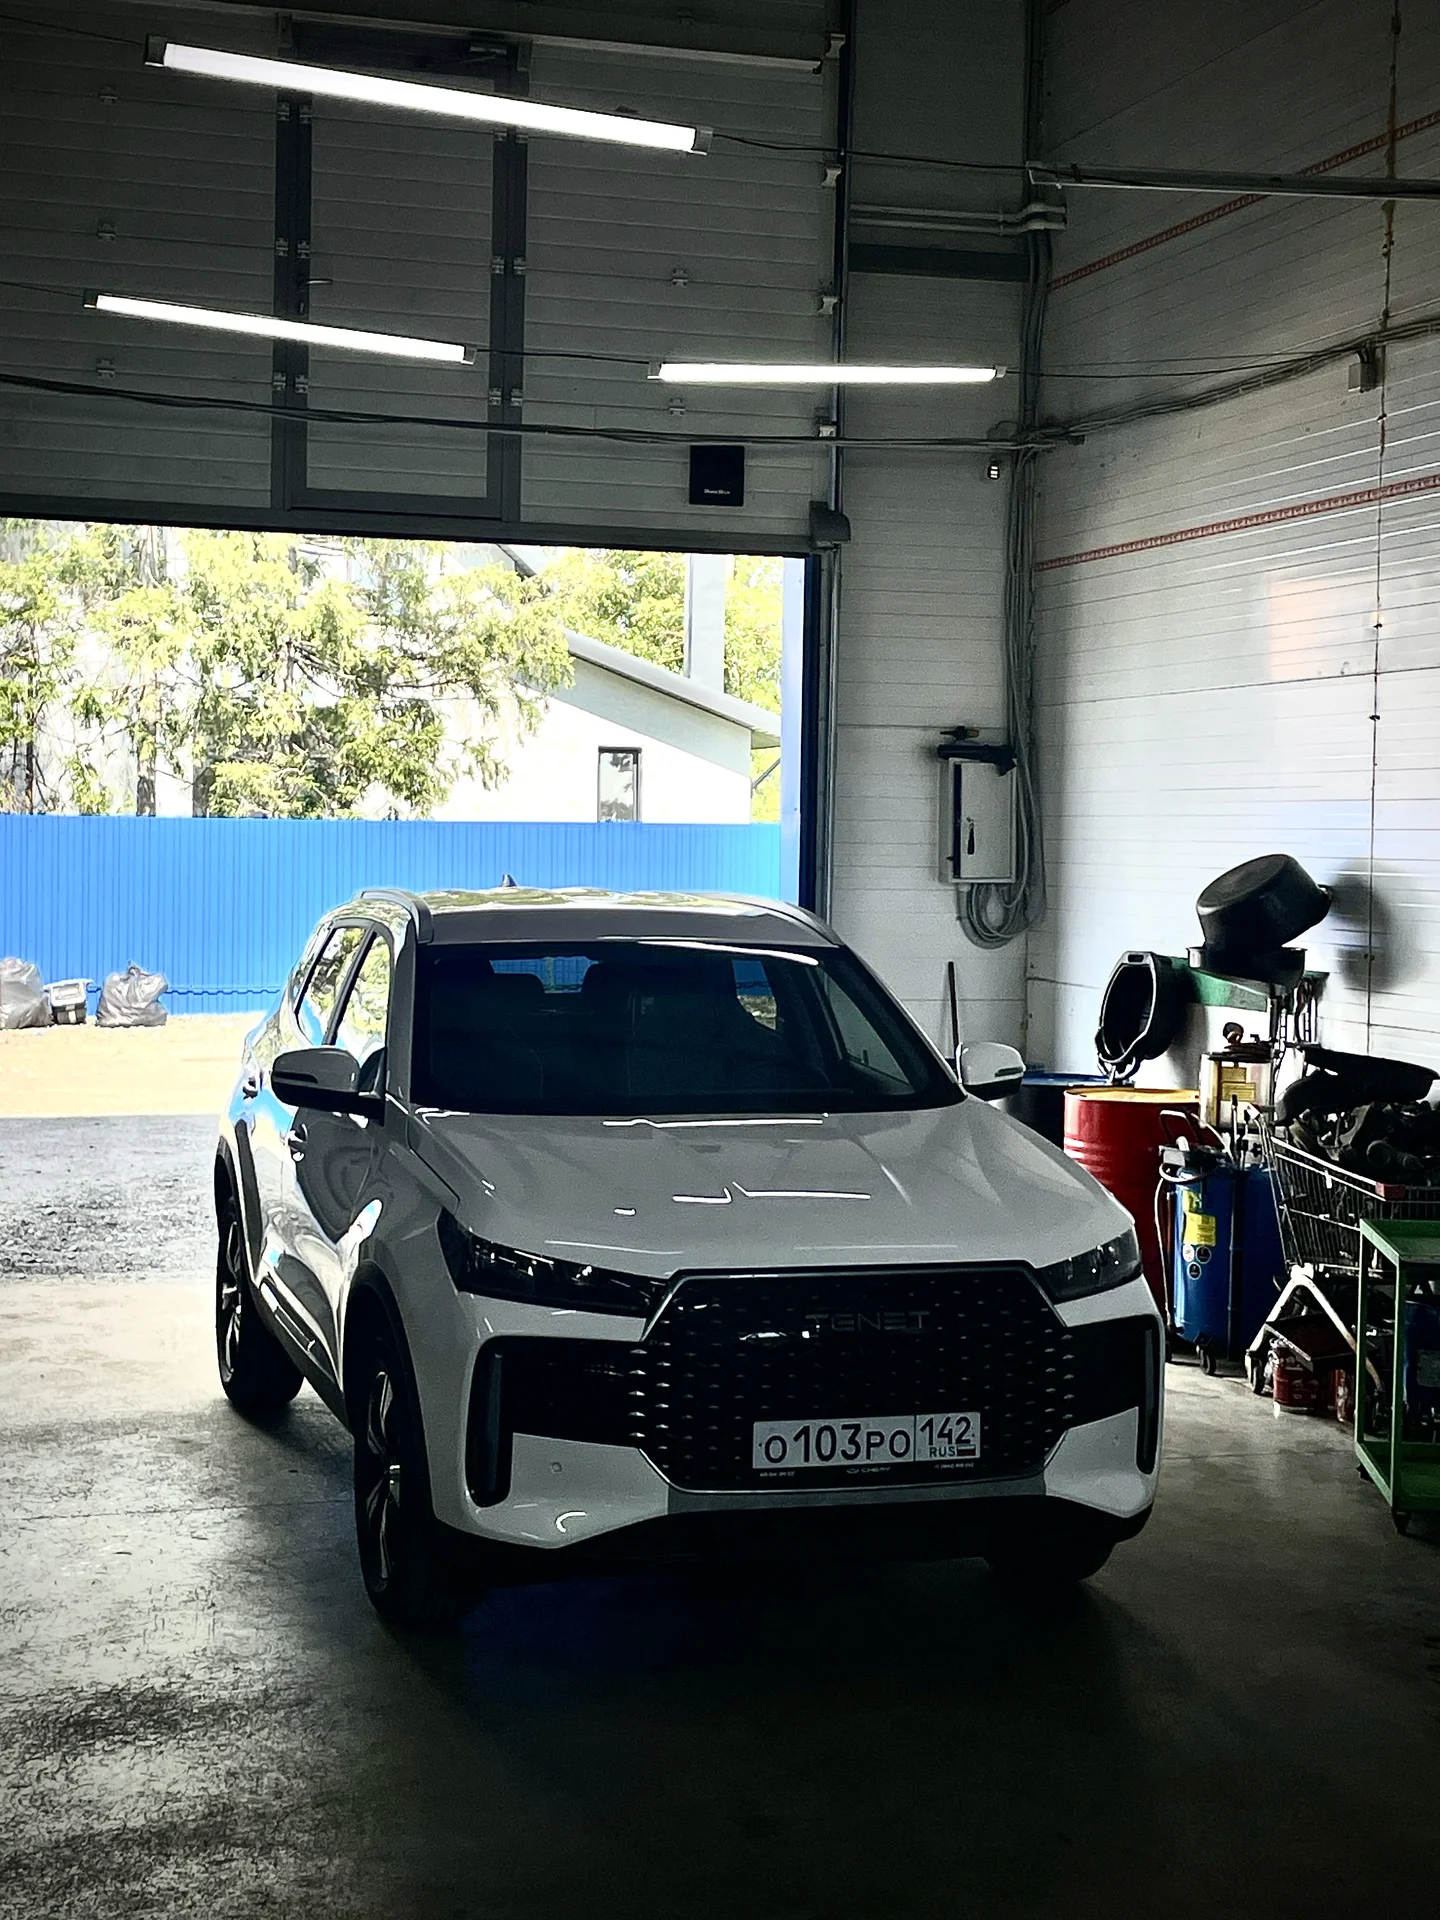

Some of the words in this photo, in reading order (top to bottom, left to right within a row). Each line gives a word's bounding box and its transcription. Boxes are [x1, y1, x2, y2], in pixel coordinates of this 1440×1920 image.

[804, 1310, 931, 1332] TENET
[919, 1416, 971, 1446] 142
[929, 1446, 956, 1458] RUS
